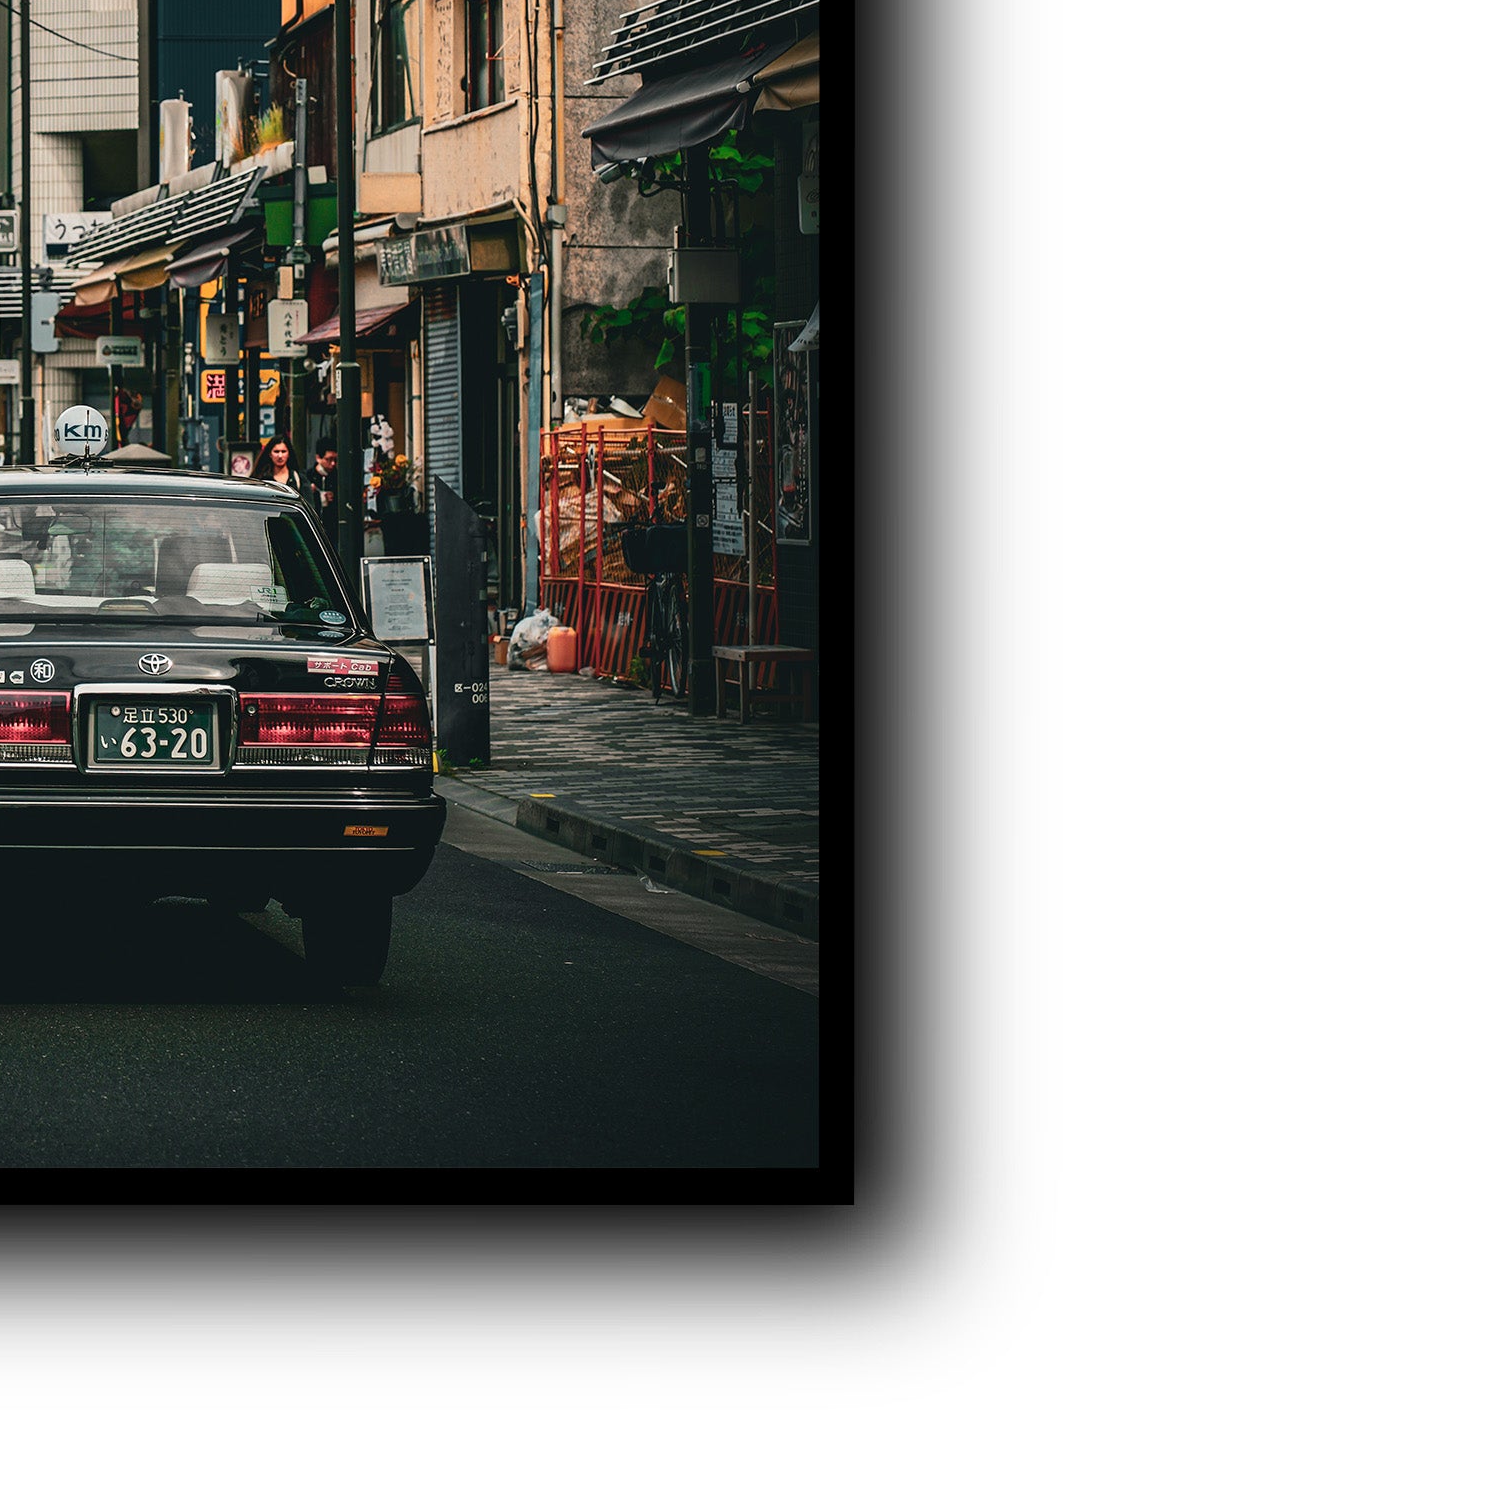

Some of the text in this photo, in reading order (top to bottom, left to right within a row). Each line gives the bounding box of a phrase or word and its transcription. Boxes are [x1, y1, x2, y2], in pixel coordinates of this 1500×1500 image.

[33, 661, 52, 680] 和
[314, 661, 372, 671] サポート Cab
[324, 677, 377, 689] CROWN
[123, 708, 188, 724] 足立 530
[101, 727, 208, 759] い 63-20
